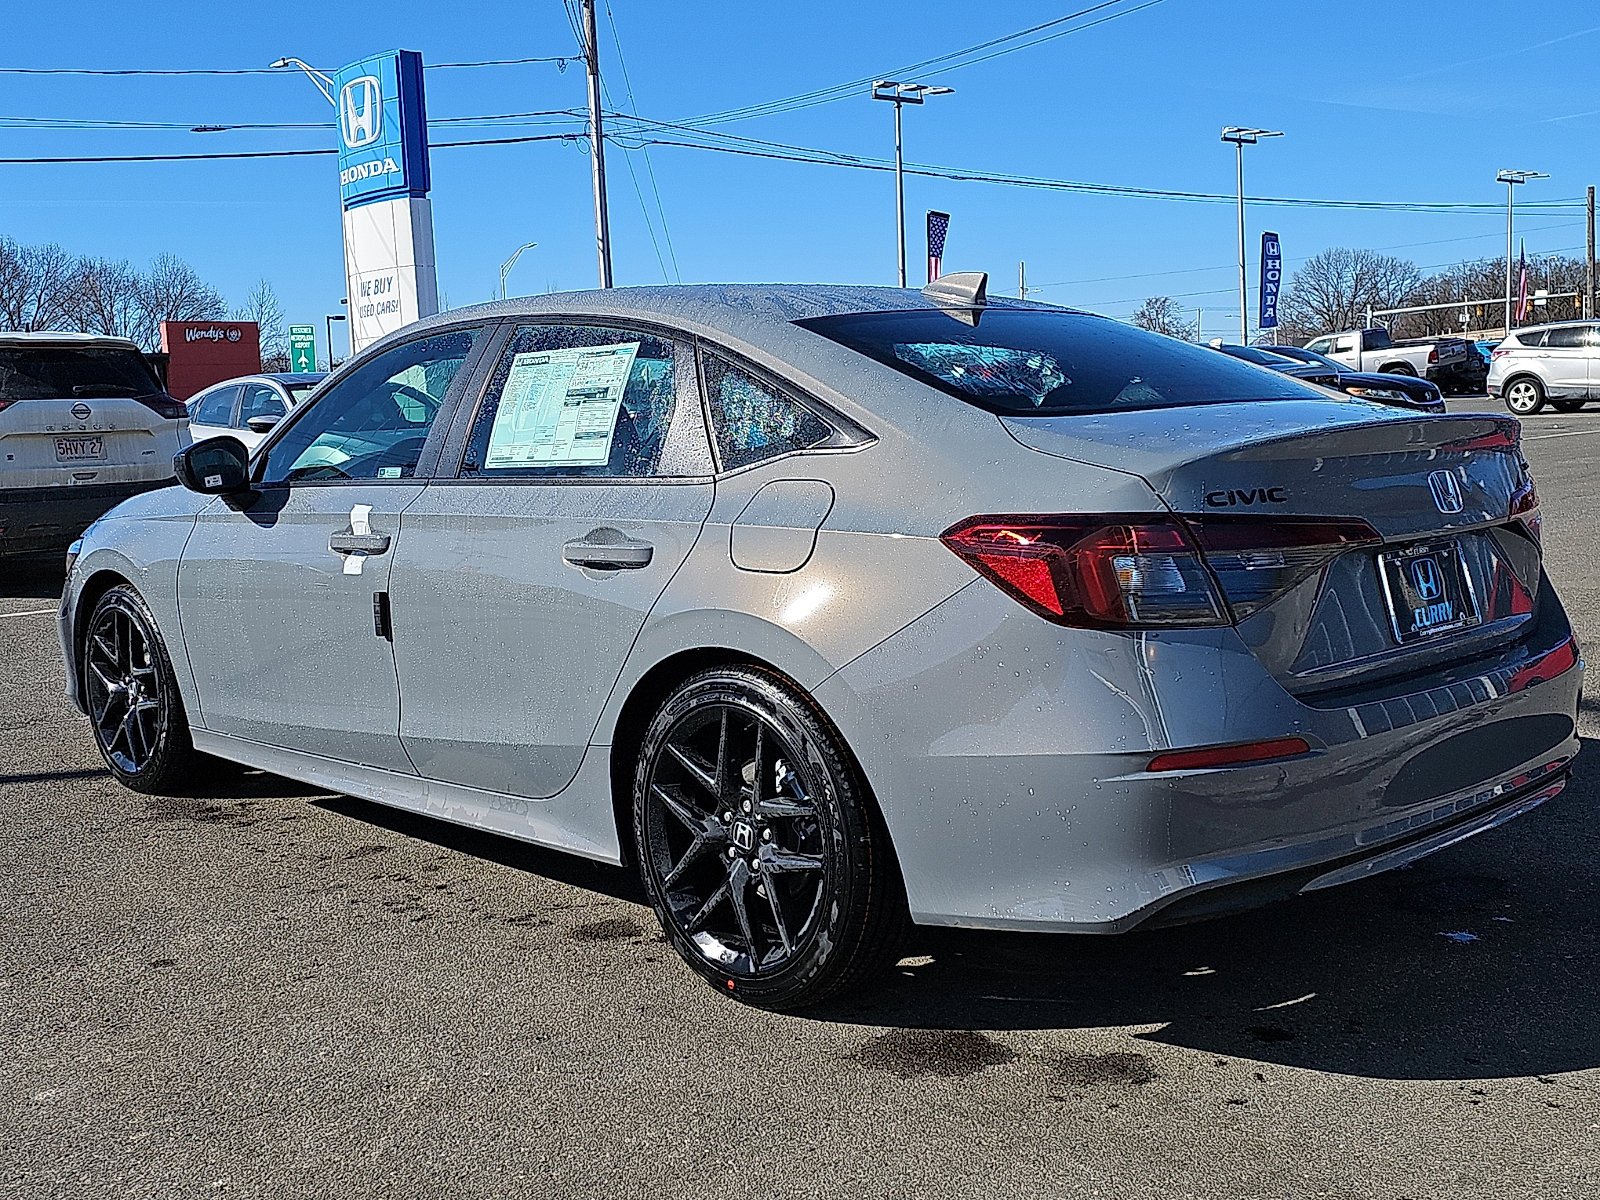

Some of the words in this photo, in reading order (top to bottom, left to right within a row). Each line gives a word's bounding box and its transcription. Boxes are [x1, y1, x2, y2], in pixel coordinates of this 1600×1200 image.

[340, 157, 400, 186] HONDA
[360, 280, 371, 297] WE
[374, 276, 393, 295] BUY
[1264, 259, 1280, 317] HONDA
[360, 303, 375, 319] USED
[376, 299, 399, 315] CARS!
[185, 325, 224, 342] Wendy's
[57, 442, 85, 455] 5HVY
[90, 441, 103, 454] 27
[1205, 487, 1288, 507] CIVIC
[1414, 600, 1453, 627] CURRY
